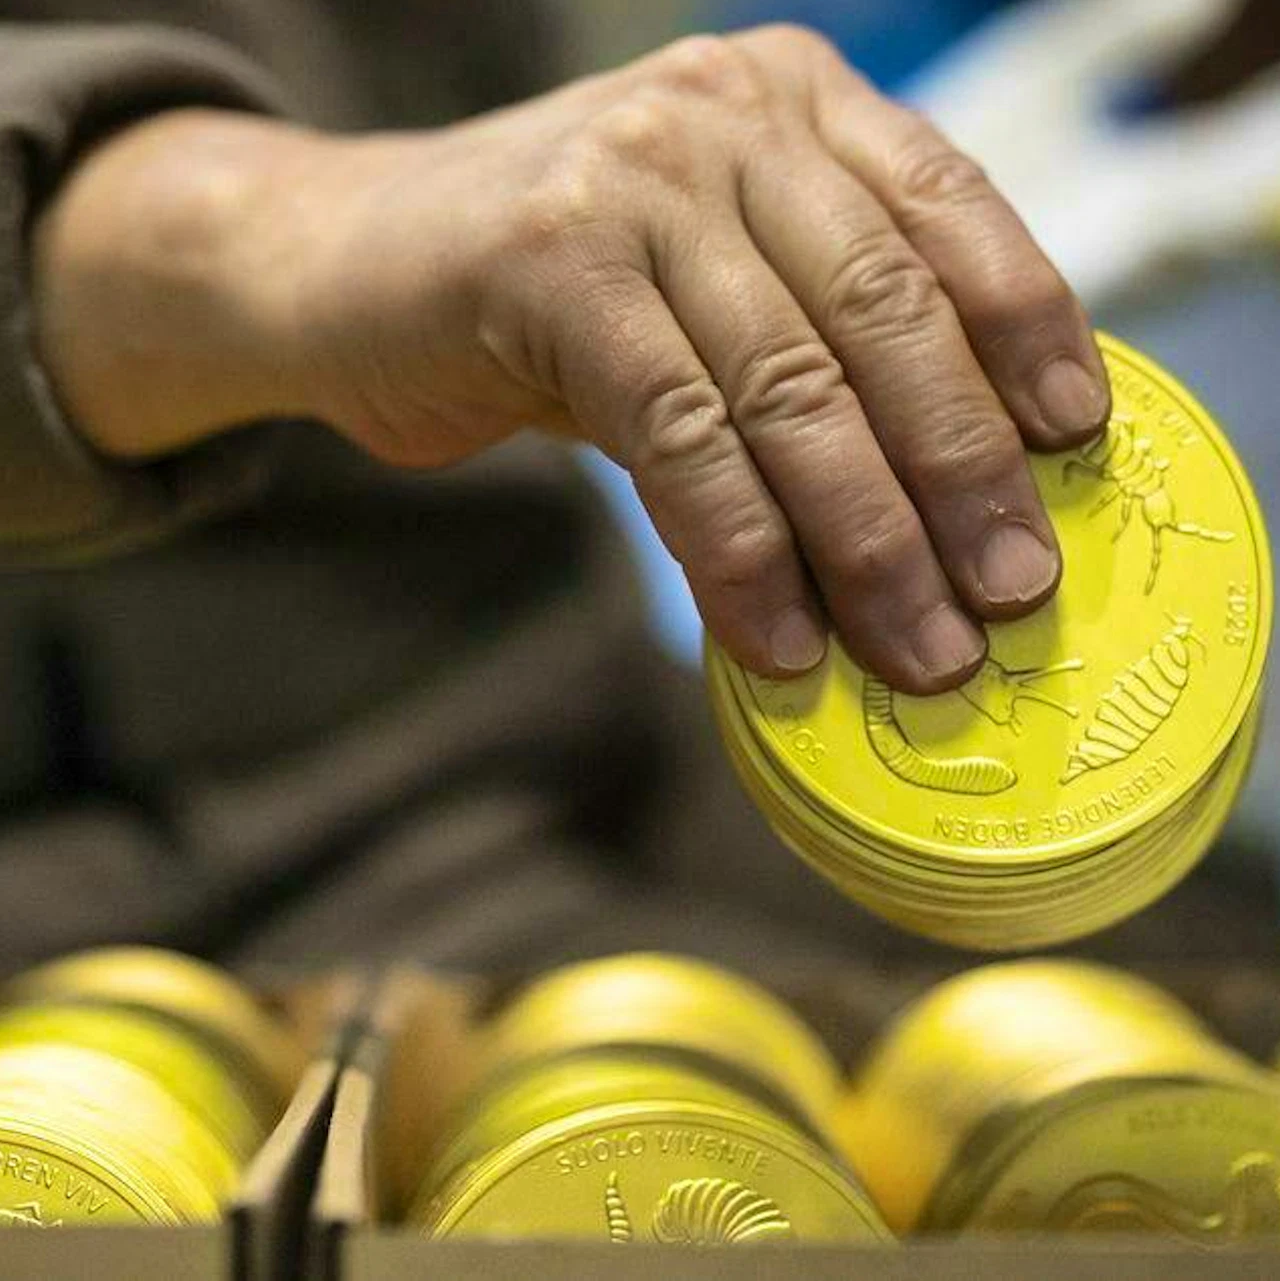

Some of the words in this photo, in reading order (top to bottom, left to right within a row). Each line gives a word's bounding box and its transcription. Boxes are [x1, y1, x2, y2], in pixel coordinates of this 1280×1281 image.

[1040, 754, 1177, 839] LEBENDIGE
[555, 1130, 646, 1174] SUOLO
[654, 1129, 771, 1176] VIVENTE
[65, 1174, 112, 1215] VIV
